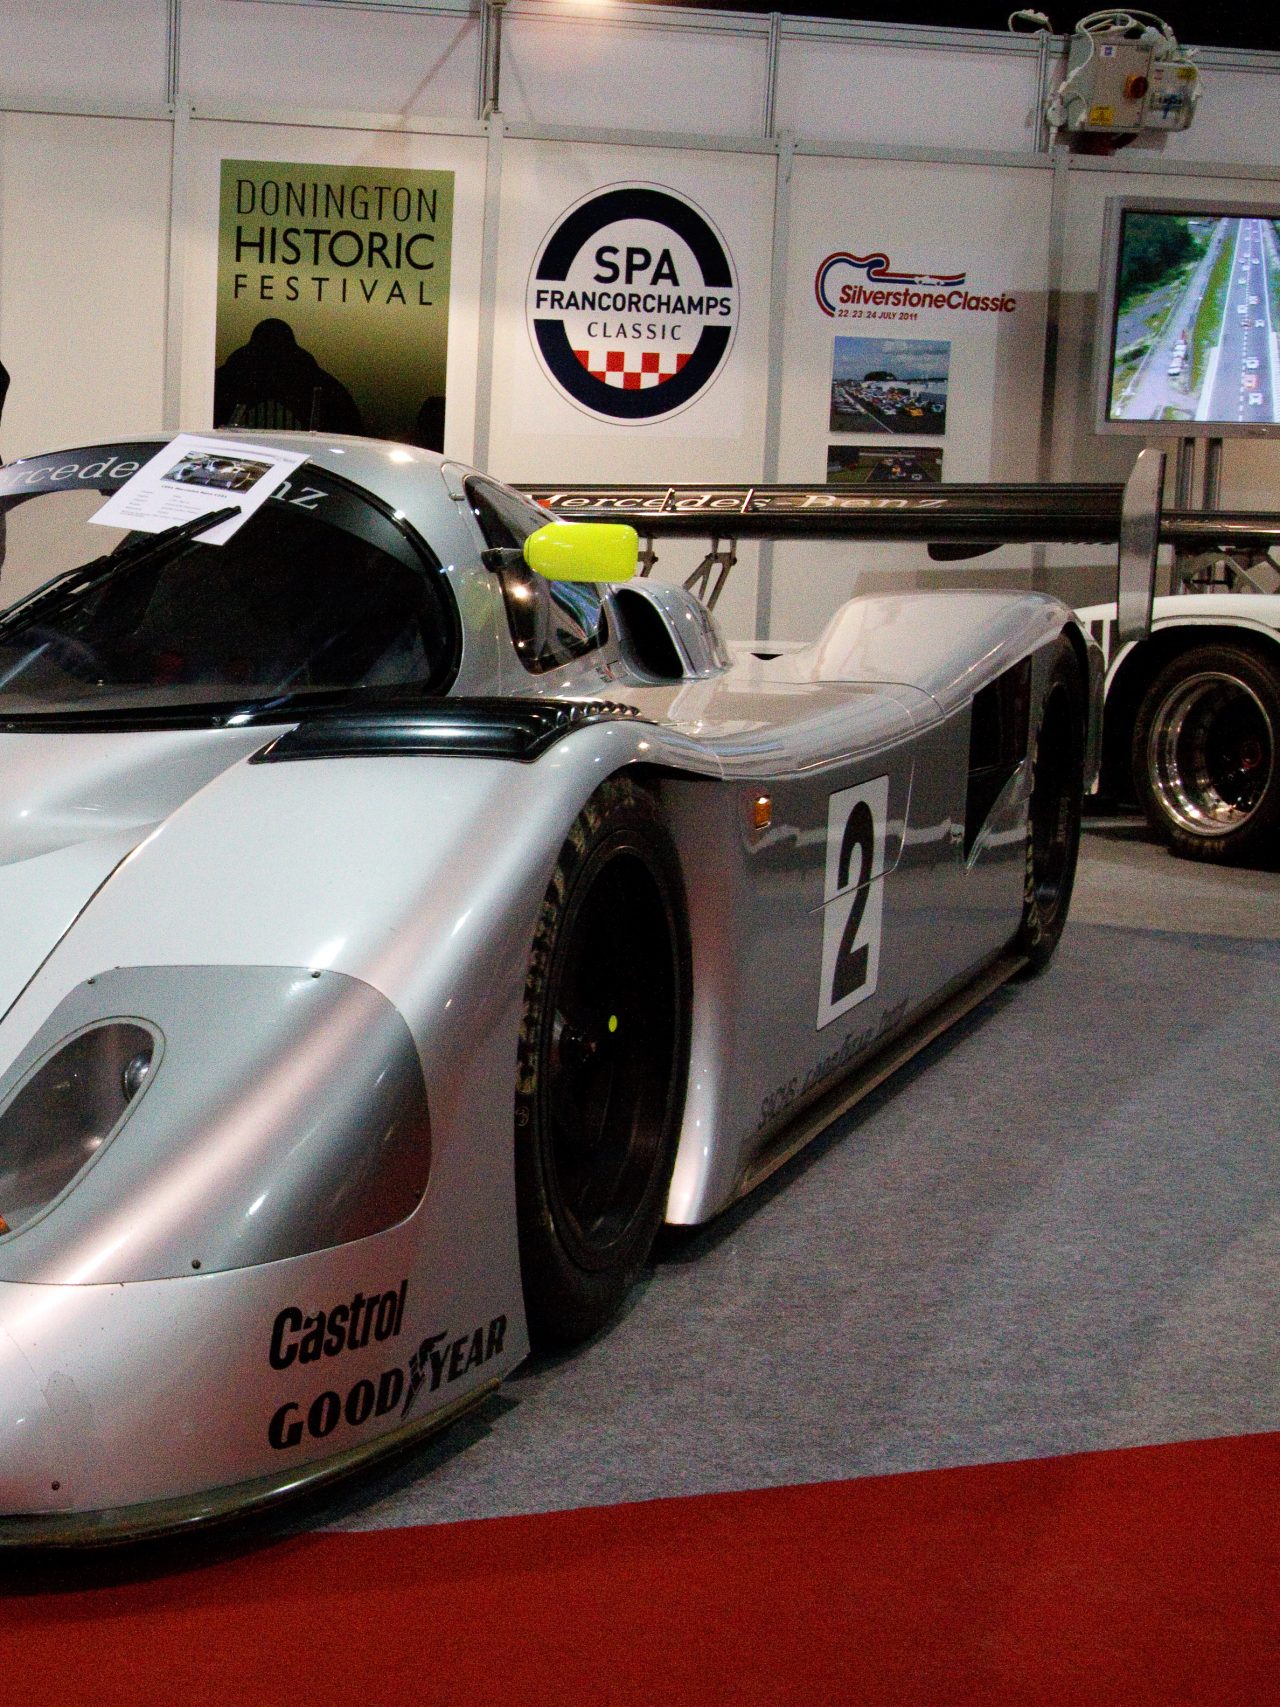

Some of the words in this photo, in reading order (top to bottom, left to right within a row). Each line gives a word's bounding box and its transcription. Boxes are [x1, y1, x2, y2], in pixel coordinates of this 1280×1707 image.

[236, 179, 437, 222] DONINGTON
[235, 226, 435, 270] HISTORIC
[593, 245, 680, 287] SPA
[234, 274, 433, 306] FESTIVAL
[536, 289, 732, 316] FRANCORCHAMPS
[839, 284, 1017, 313] SilverstoneClassic
[587, 321, 682, 341] CLASSIC
[838, 309, 849, 318] 22
[852, 310, 863, 319] 23
[866, 310, 877, 319] 24
[878, 311, 896, 320] JULY
[898, 312, 918, 321] 2011
[831, 801, 874, 1006] 2
[269, 1279, 409, 1371] Castrol
[268, 1314, 508, 1450] GOODYEAR
